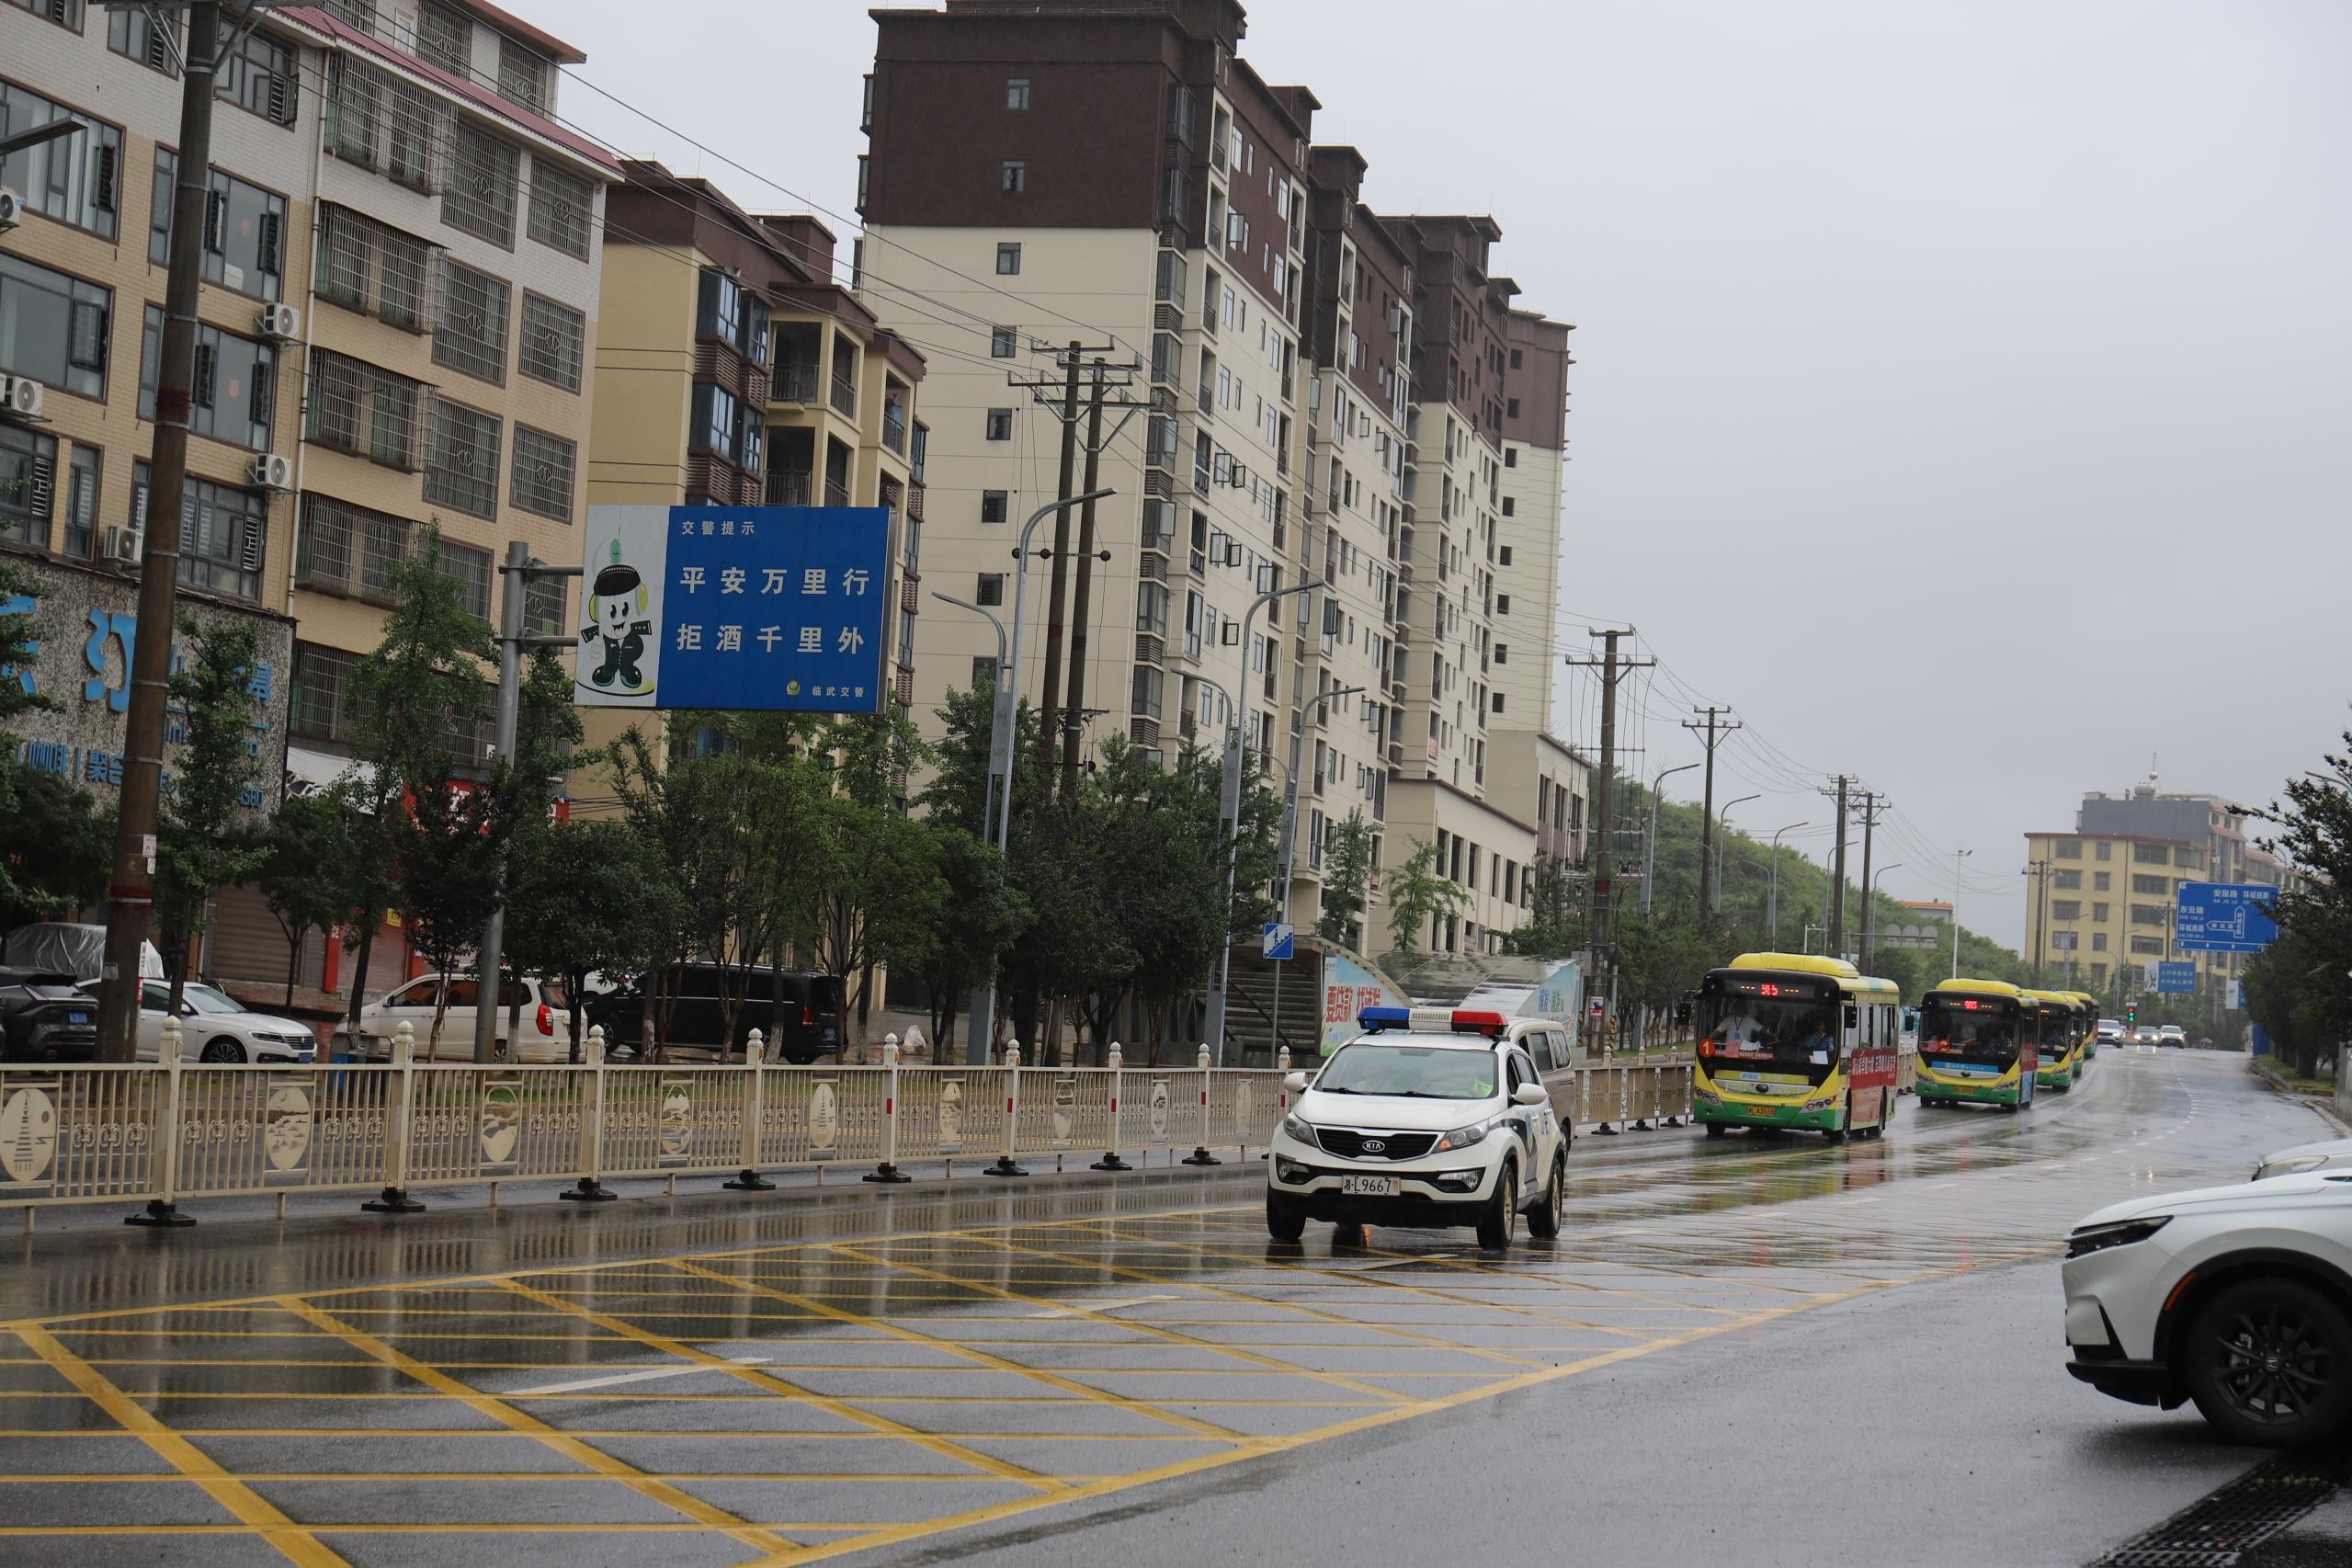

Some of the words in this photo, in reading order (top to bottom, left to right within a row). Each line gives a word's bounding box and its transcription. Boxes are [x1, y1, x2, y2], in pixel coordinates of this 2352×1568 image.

[682, 520, 755, 535] 交警提示
[680, 567, 869, 596] 平安万里行
[676, 623, 864, 654] 拒酒千里外
[812, 686, 864, 698] 临武交警
[1702, 1040, 1710, 1055] 1
